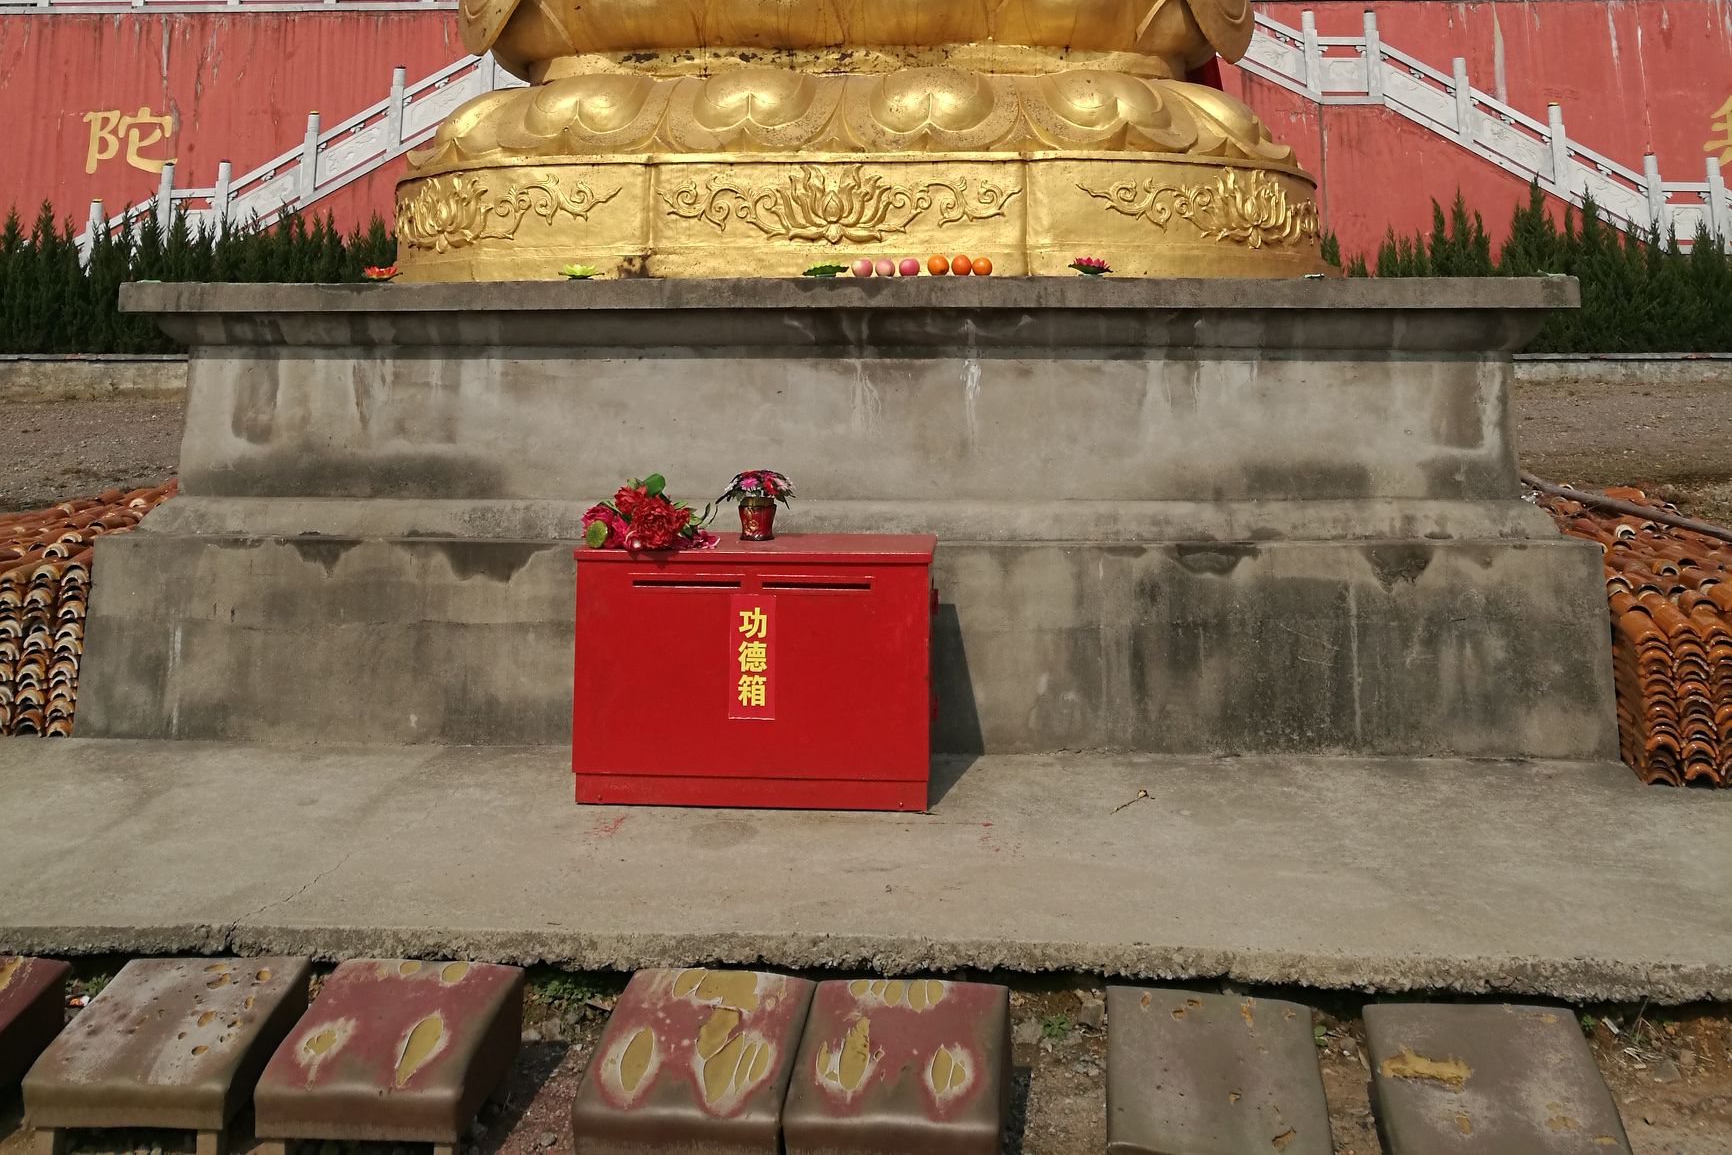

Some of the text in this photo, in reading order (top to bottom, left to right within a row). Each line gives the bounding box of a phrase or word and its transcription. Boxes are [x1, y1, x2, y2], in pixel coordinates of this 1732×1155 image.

[82, 106, 178, 175] 陀
[737, 606, 768, 707] 功德箱
